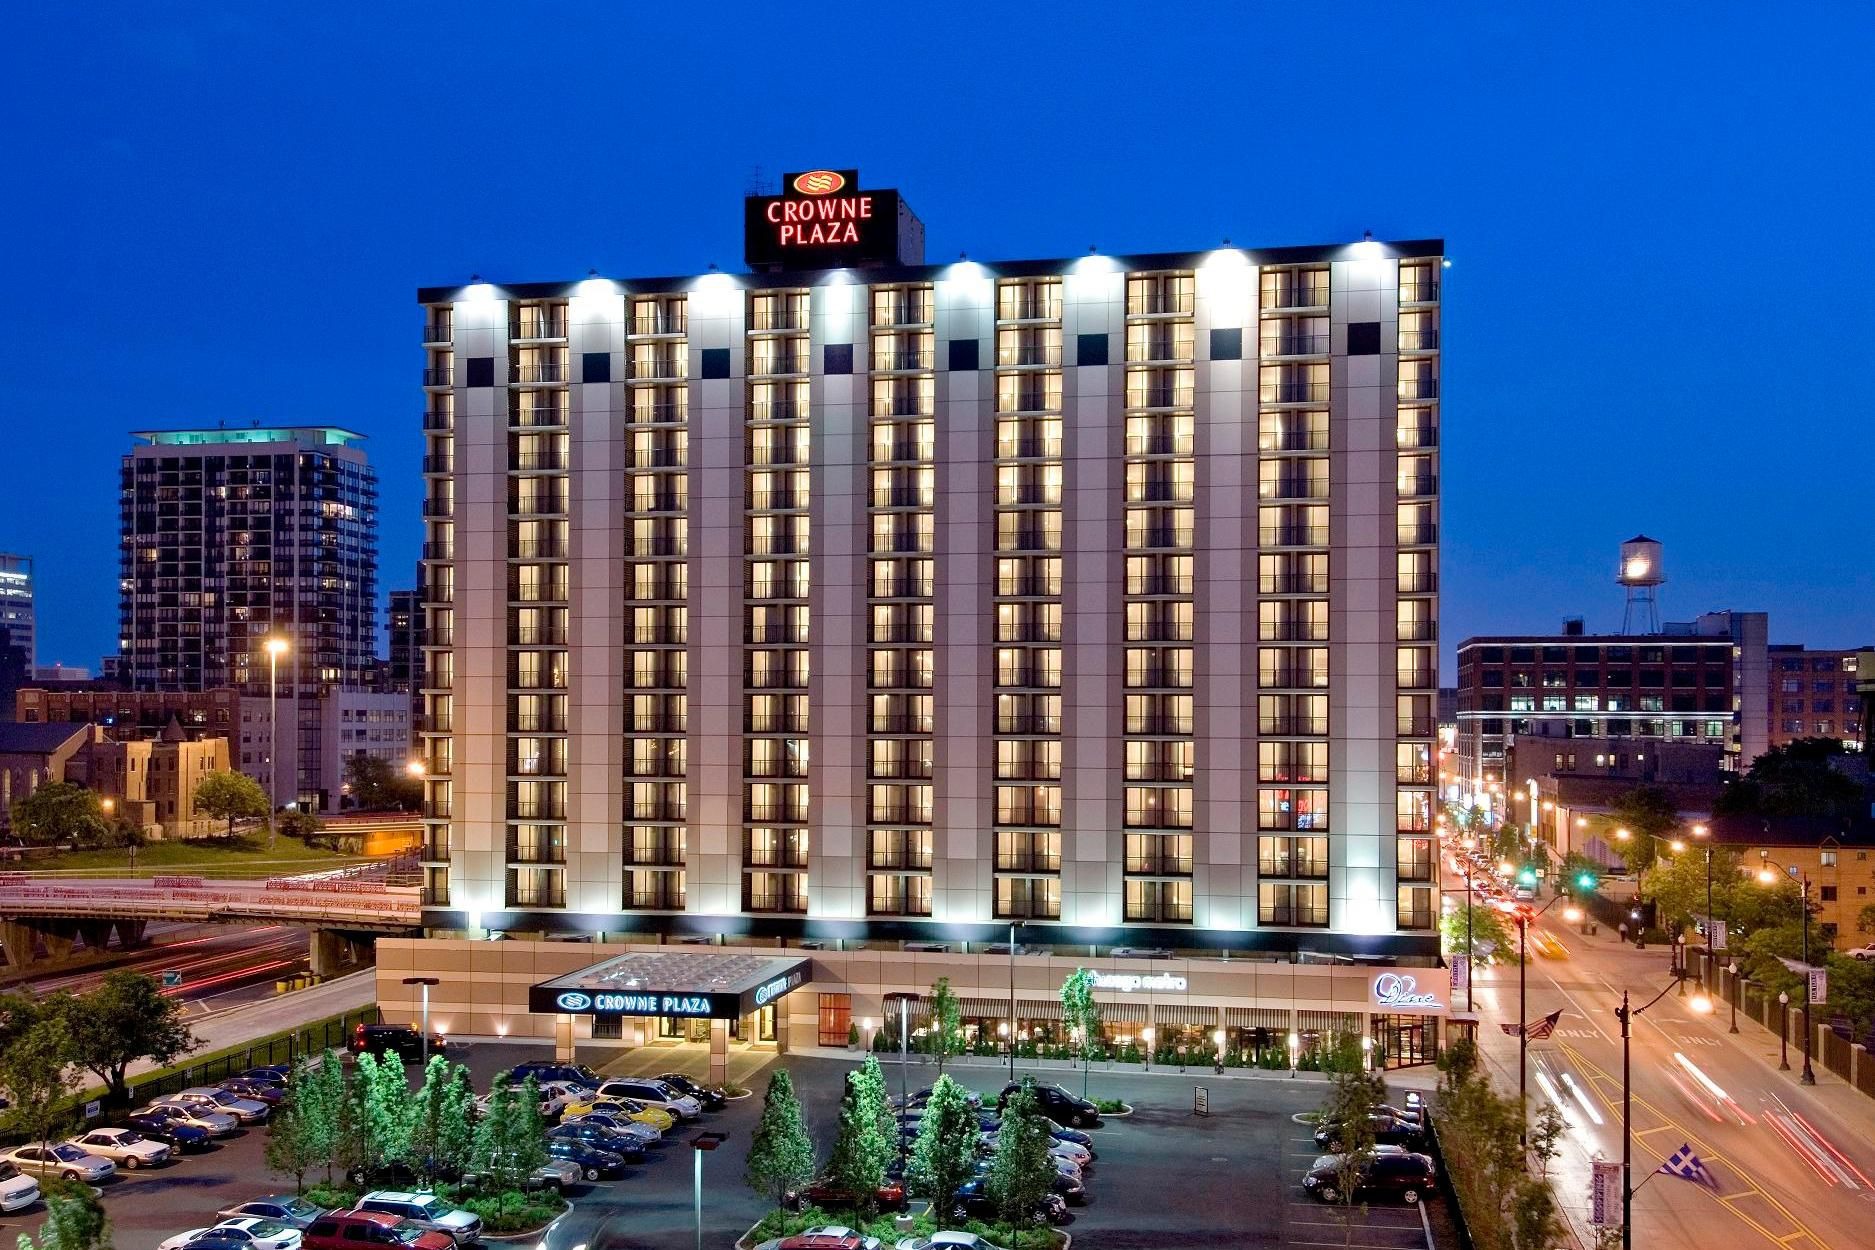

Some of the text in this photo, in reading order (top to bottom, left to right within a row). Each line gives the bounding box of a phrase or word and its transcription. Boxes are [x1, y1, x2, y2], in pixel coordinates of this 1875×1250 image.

[768, 198, 872, 223] CROWNE
[781, 222, 859, 245] PLAZA
[595, 994, 711, 1013] CROWNE PLAZA
[1556, 1030, 1600, 1038] ONLY
